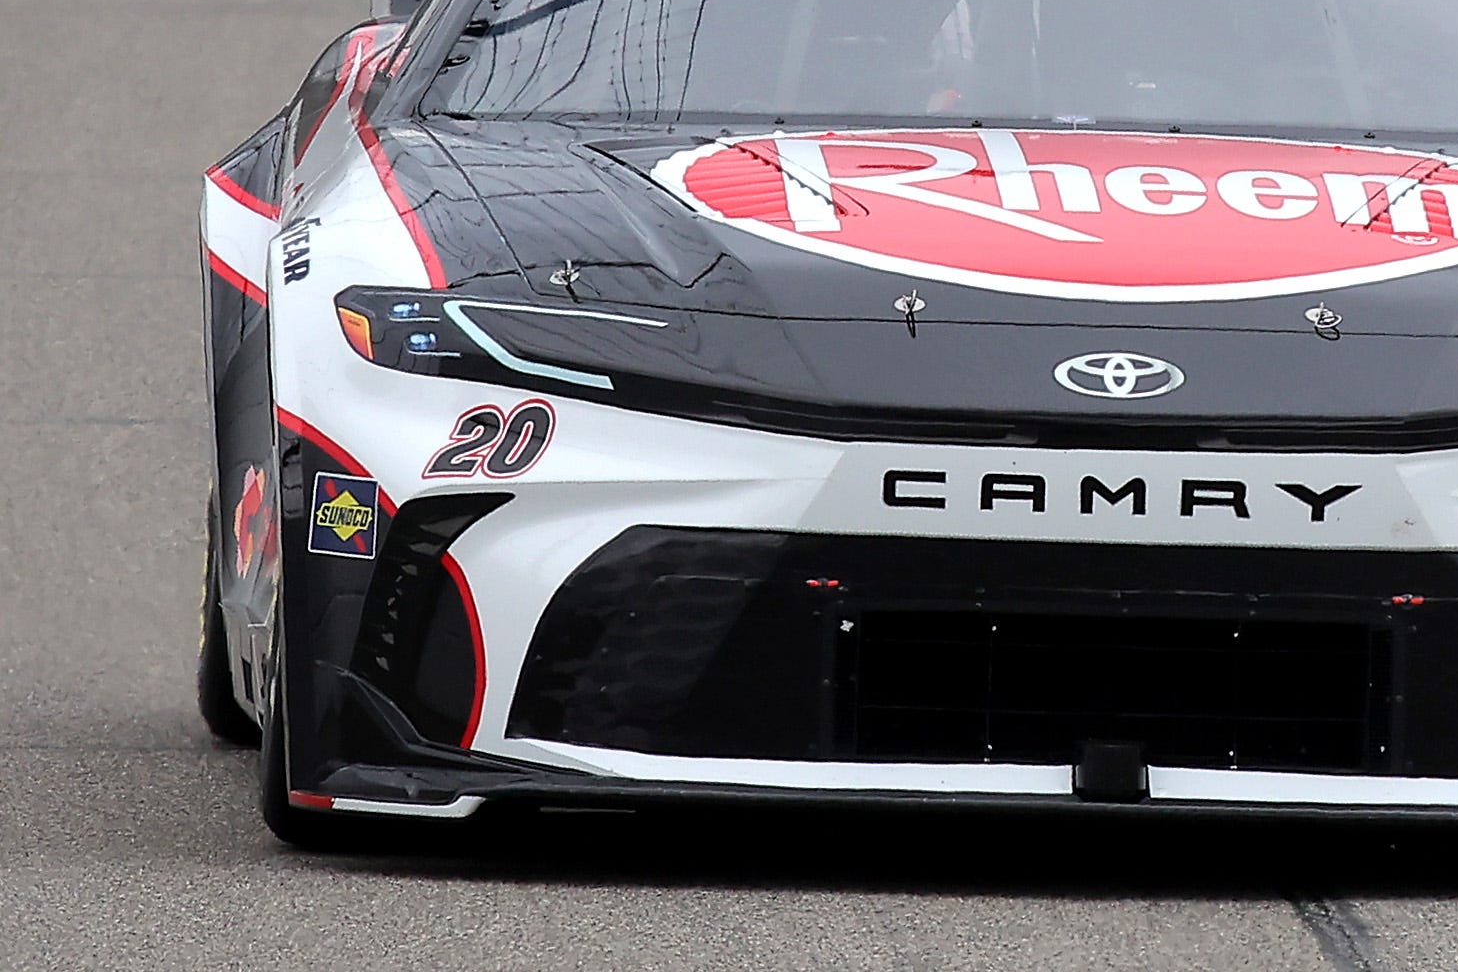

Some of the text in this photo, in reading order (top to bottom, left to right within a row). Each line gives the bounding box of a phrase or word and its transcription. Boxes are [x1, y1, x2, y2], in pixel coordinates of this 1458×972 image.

[421, 397, 557, 481] 20
[318, 505, 371, 528] SUNOCO
[881, 469, 1363, 523] CAMRY
